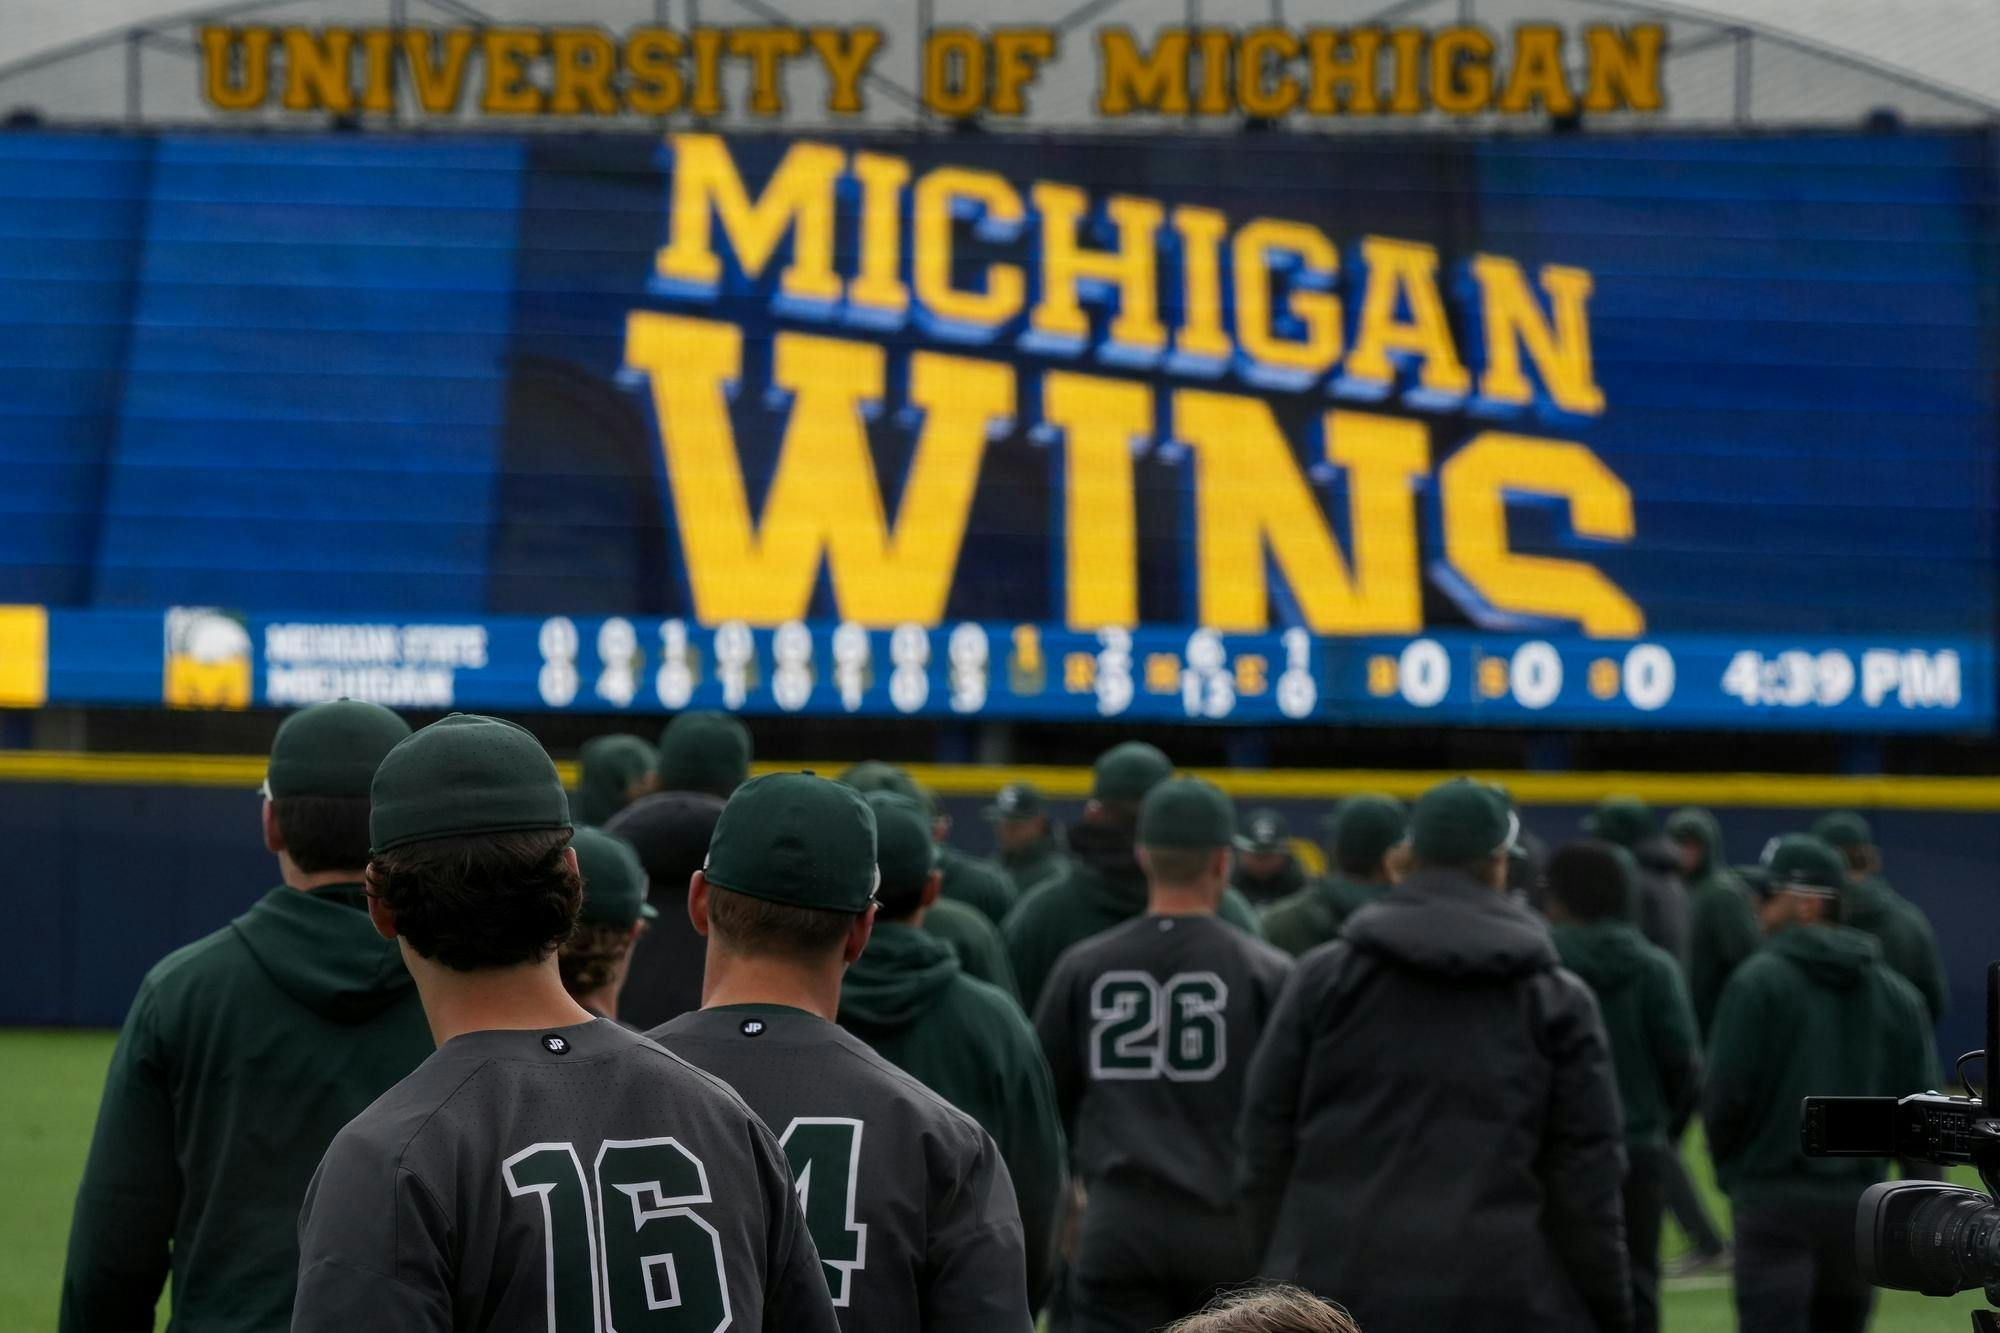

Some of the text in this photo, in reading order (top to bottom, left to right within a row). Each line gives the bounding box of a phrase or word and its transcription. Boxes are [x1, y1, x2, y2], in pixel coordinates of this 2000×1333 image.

[203, 23, 1670, 118] UNIVERSITY OF MICHIGAN
[650, 132, 1607, 418] MICHIGAN
[622, 308, 1647, 640] WINS
[1400, 638, 1451, 708] 0
[1510, 640, 1563, 710] 0
[1623, 643, 1676, 711] 0
[1720, 648, 1961, 709] 4:39 PM
[548, 1038, 565, 1051] JP
[744, 1022, 762, 1033] JP
[1090, 970, 1229, 1082] 26
[502, 1136, 733, 1333] 16
